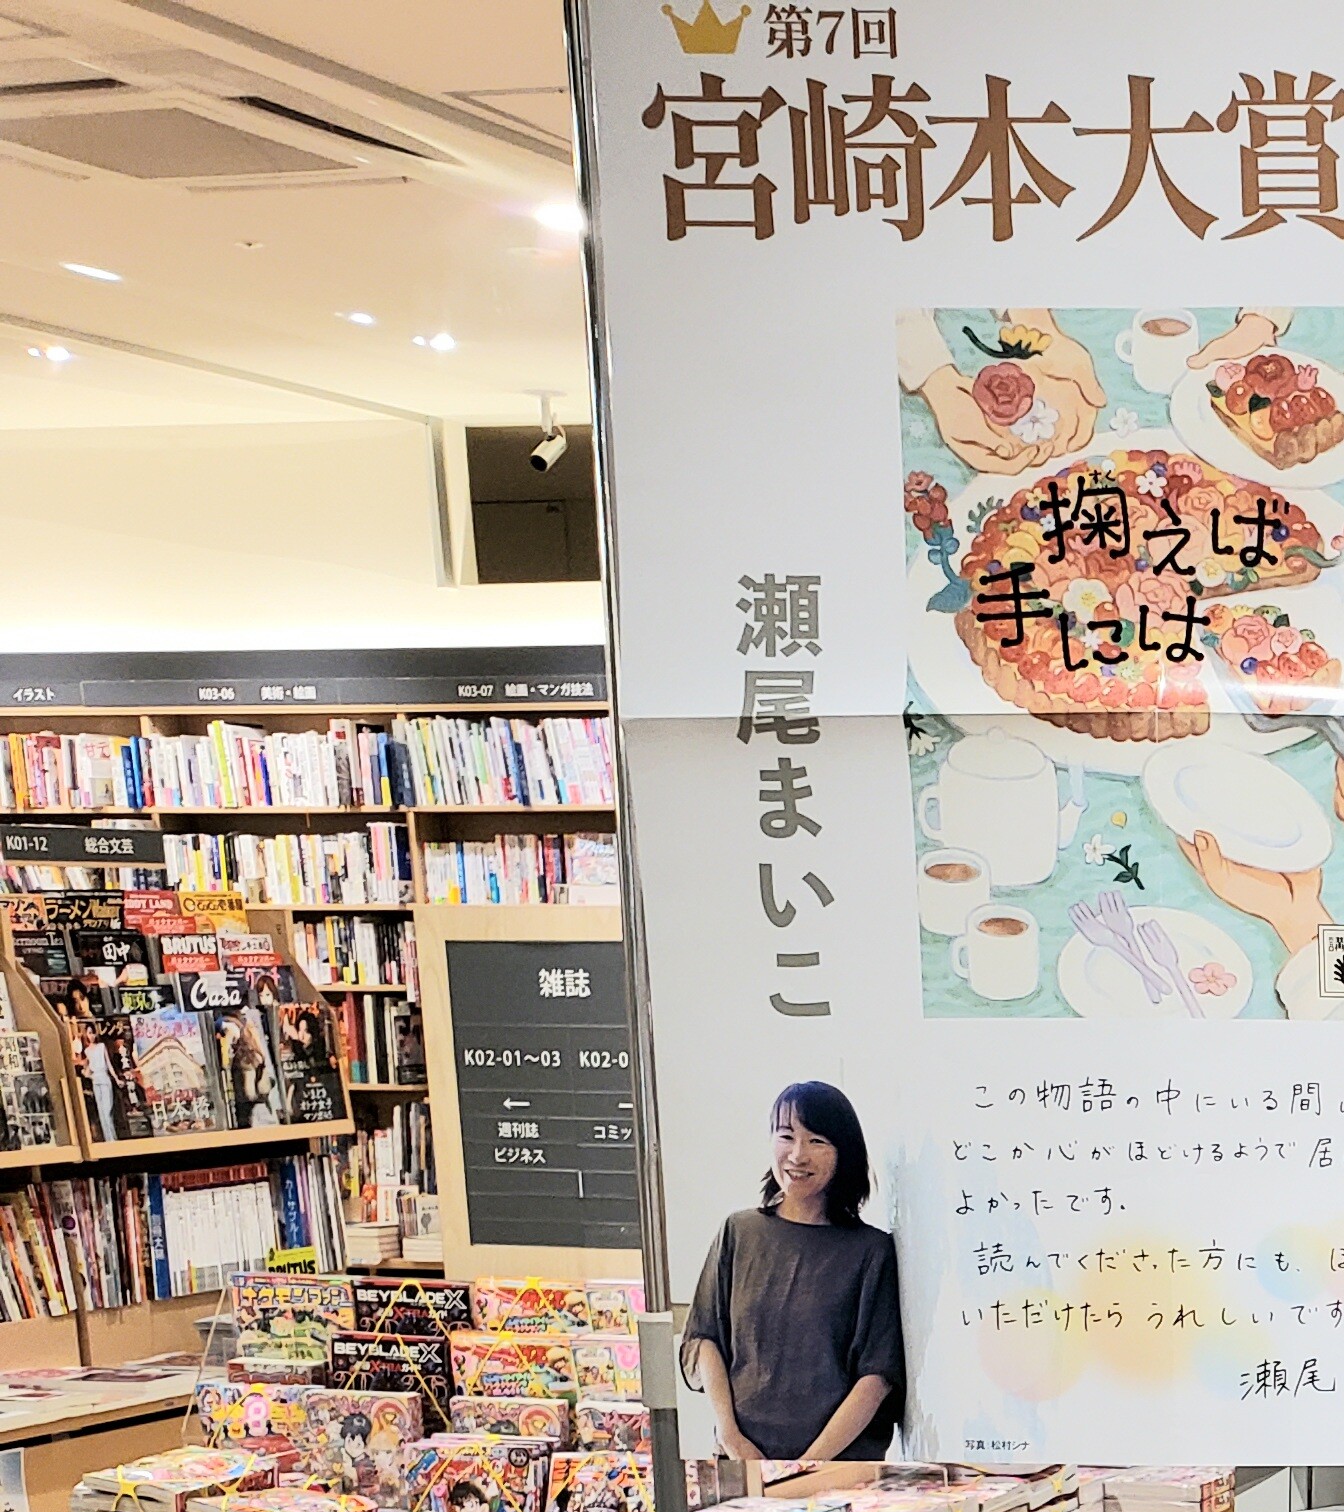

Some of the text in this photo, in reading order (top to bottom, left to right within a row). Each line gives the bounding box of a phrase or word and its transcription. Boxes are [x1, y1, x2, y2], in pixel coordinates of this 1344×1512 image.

[766, 4, 897, 60] 第7回
[1040, 476, 1289, 576] 掬えば
[977, 562, 1210, 672] 手には
[12, 686, 56, 701] イラスト
[458, 684, 494, 698] K03-07
[735, 572, 834, 1019] 瀬尾まいこ
[5, 836, 135, 854] K01-12 総合文芸
[538, 967, 592, 1000] 雑誌
[498, 1121, 540, 1140] 週刊誌
[493, 1147, 547, 1164] ビジネス
